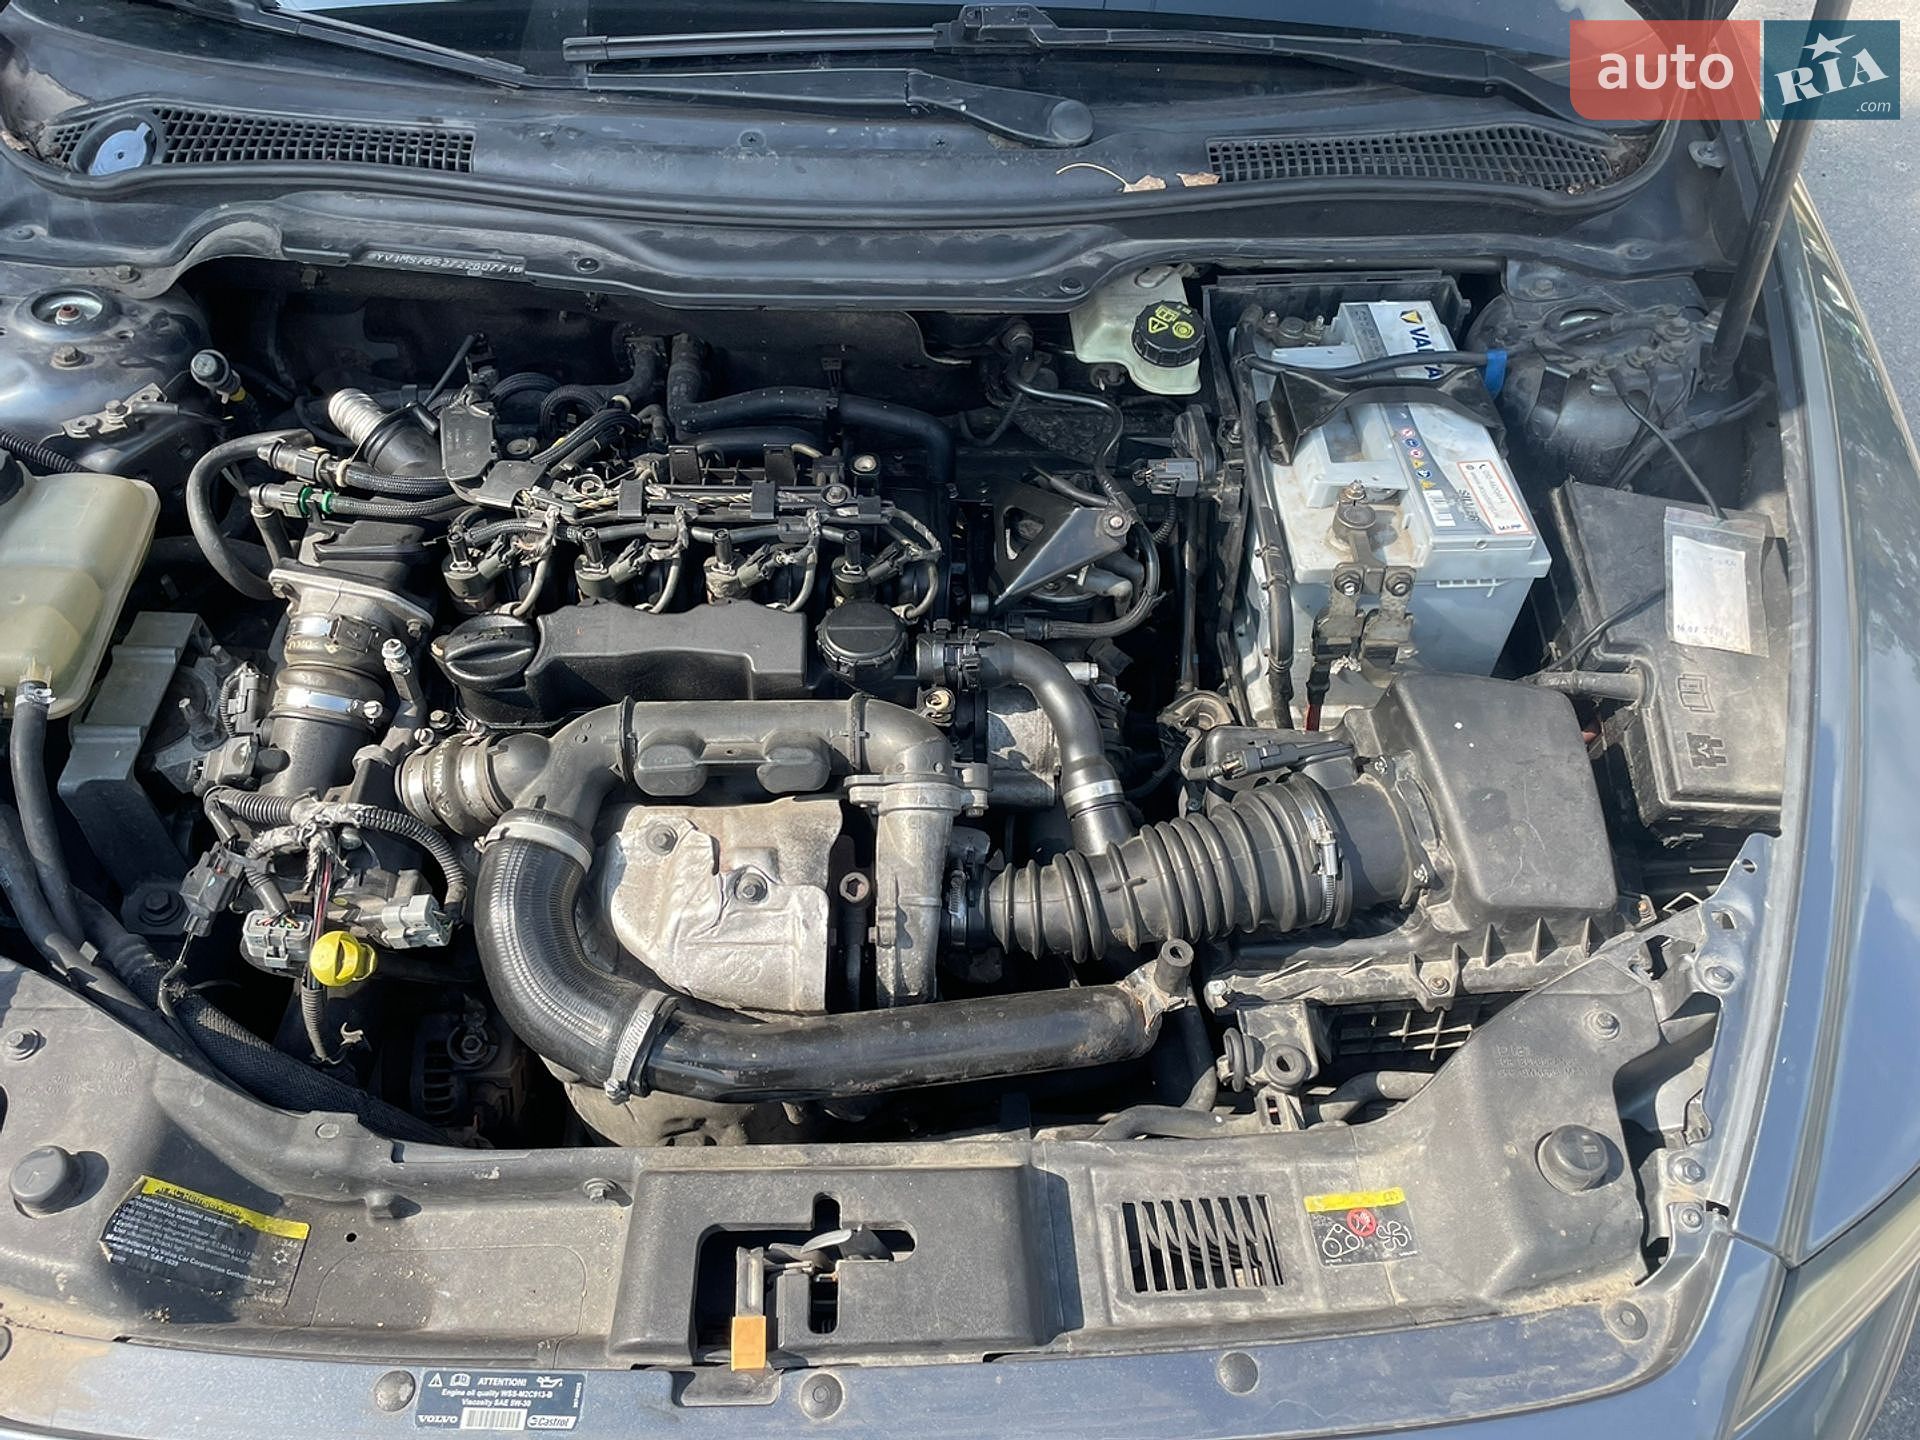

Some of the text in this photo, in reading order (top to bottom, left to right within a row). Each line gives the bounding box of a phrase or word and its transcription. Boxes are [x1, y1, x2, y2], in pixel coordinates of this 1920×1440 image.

[1409, 326, 1445, 379] VAA
[477, 1376, 528, 1387] ATTENTION!
[441, 1388, 466, 1398] Engine
[466, 1388, 476, 1397] oil
[417, 1414, 569, 1428] VOLVO Castrol
